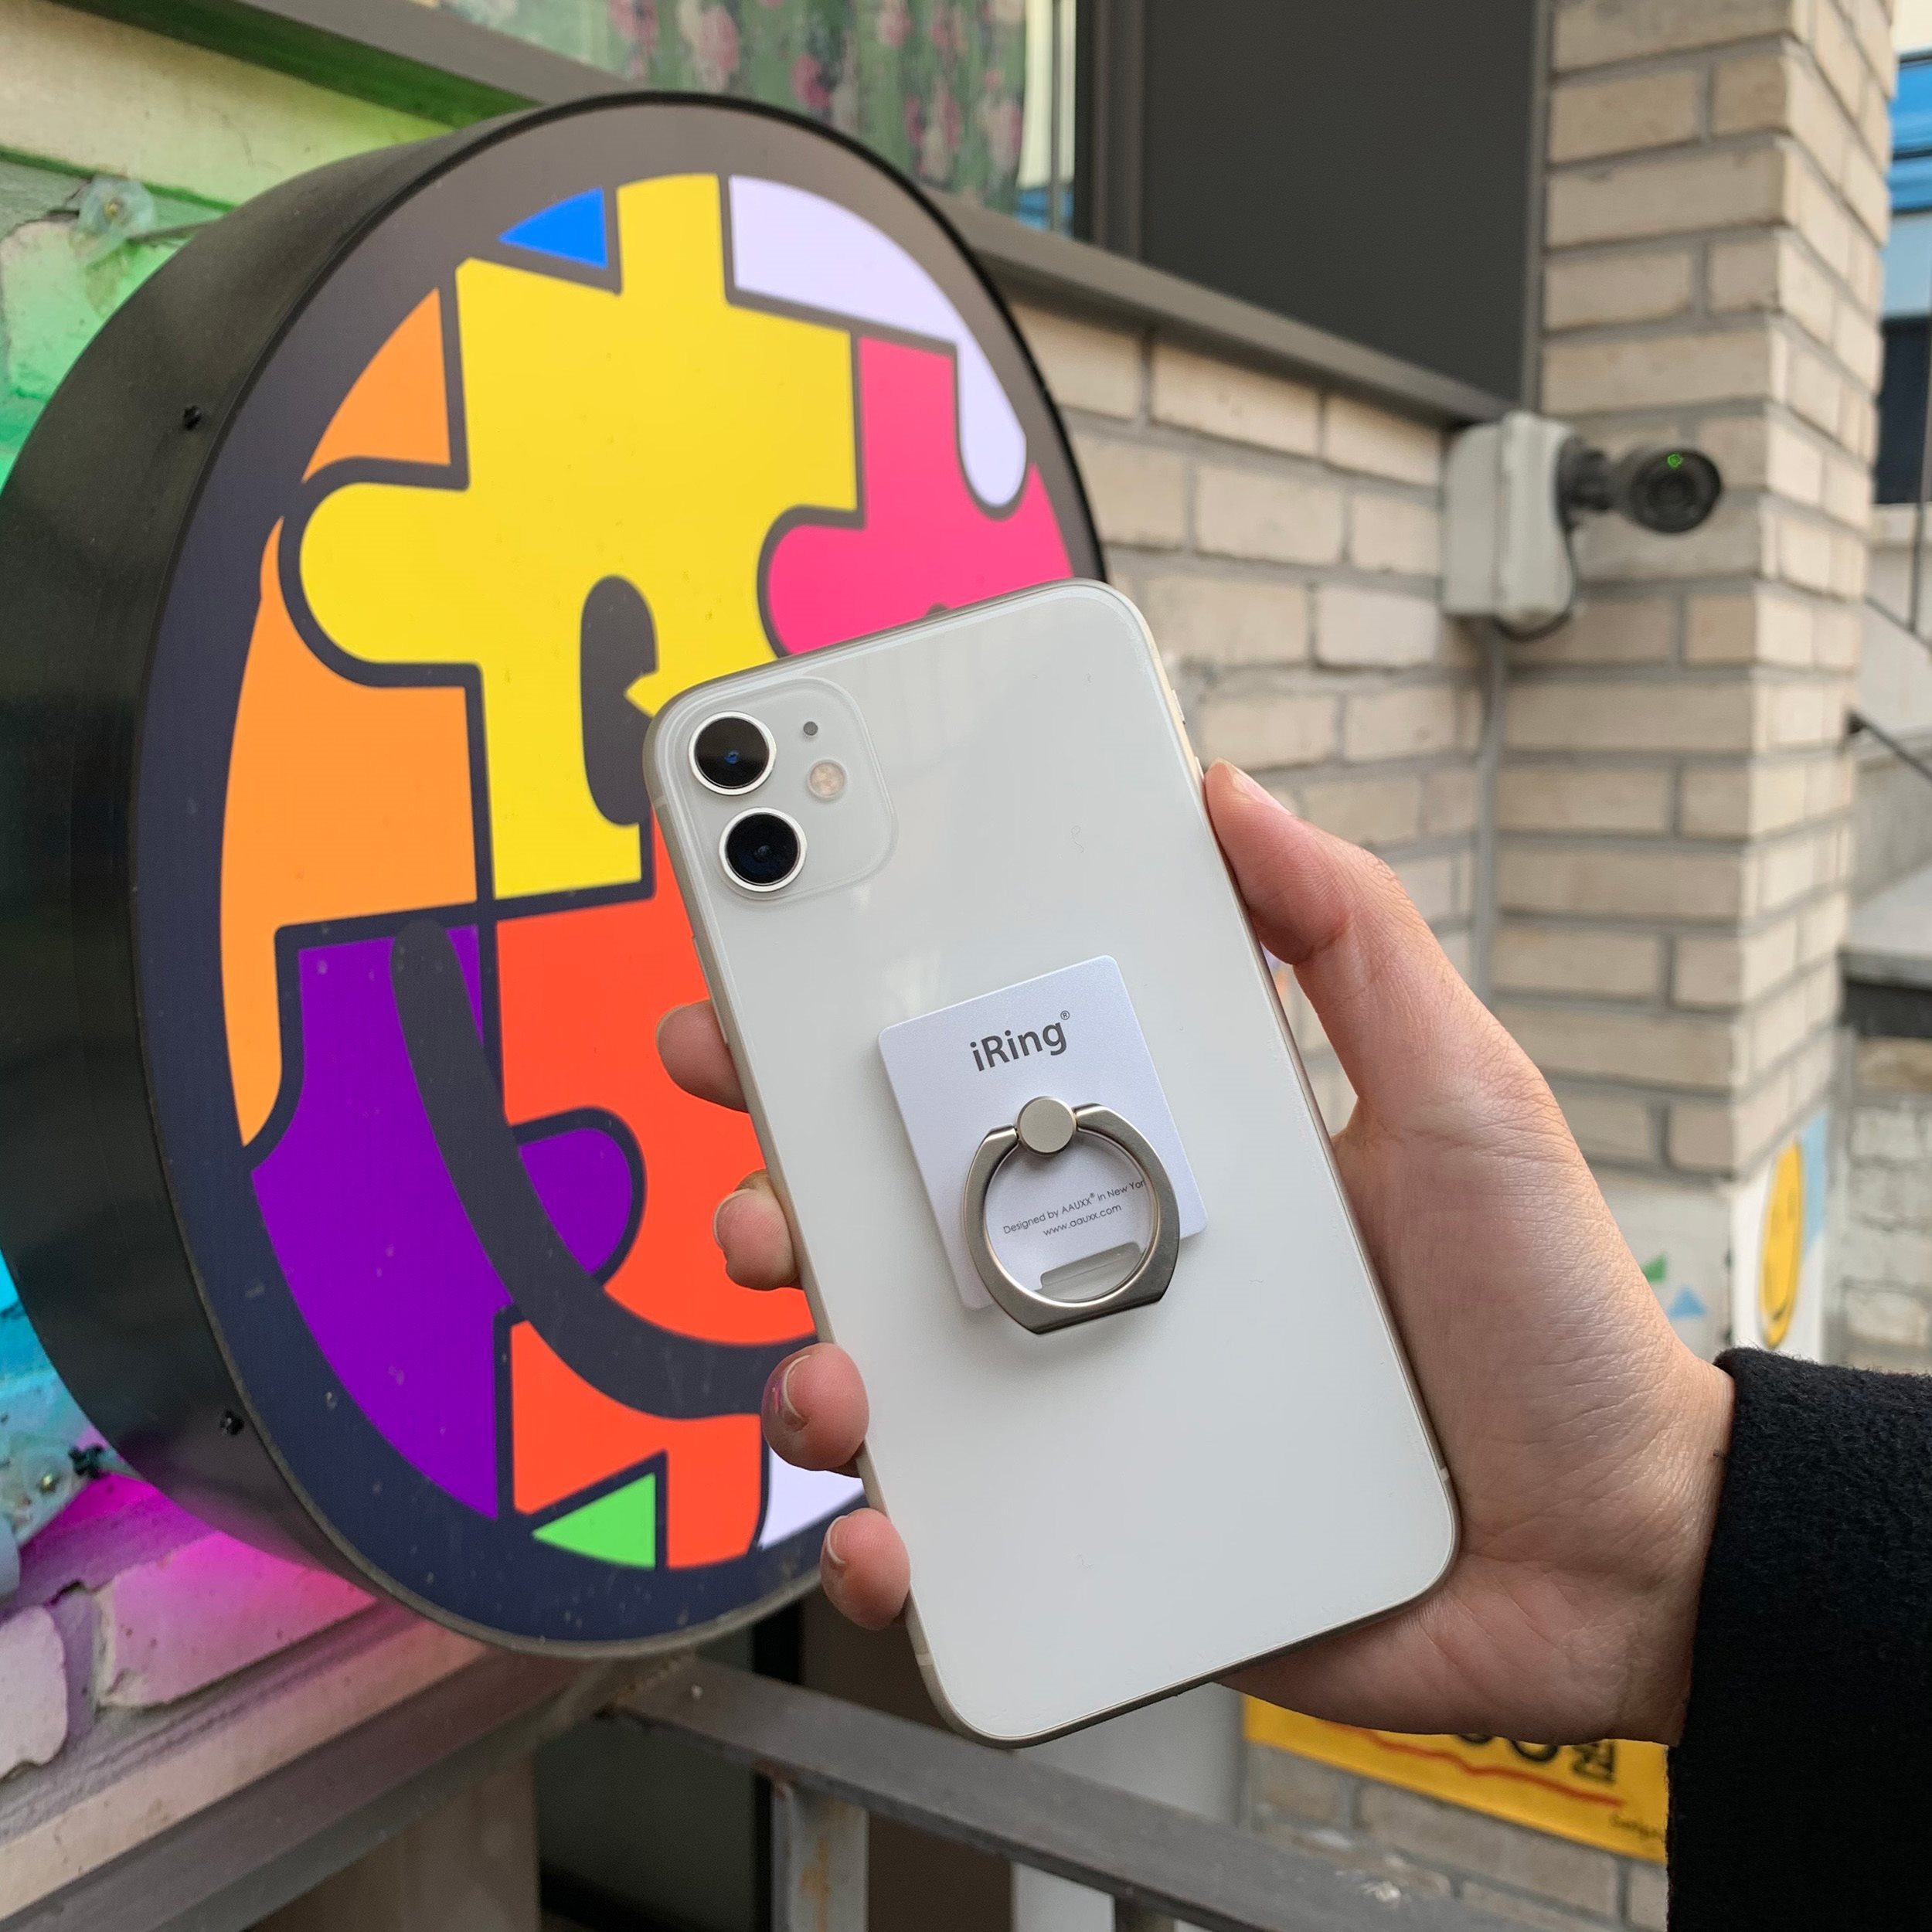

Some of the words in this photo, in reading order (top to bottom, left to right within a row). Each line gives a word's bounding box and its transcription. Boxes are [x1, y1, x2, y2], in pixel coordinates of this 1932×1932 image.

[1003, 1213, 1046, 1234] Designed
[1047, 1209, 1059, 1219] by
[1107, 1185, 1128, 1198] New
[1128, 1179, 1145, 1190] Yor
[1043, 1204, 1122, 1236] www.aauxx.com
